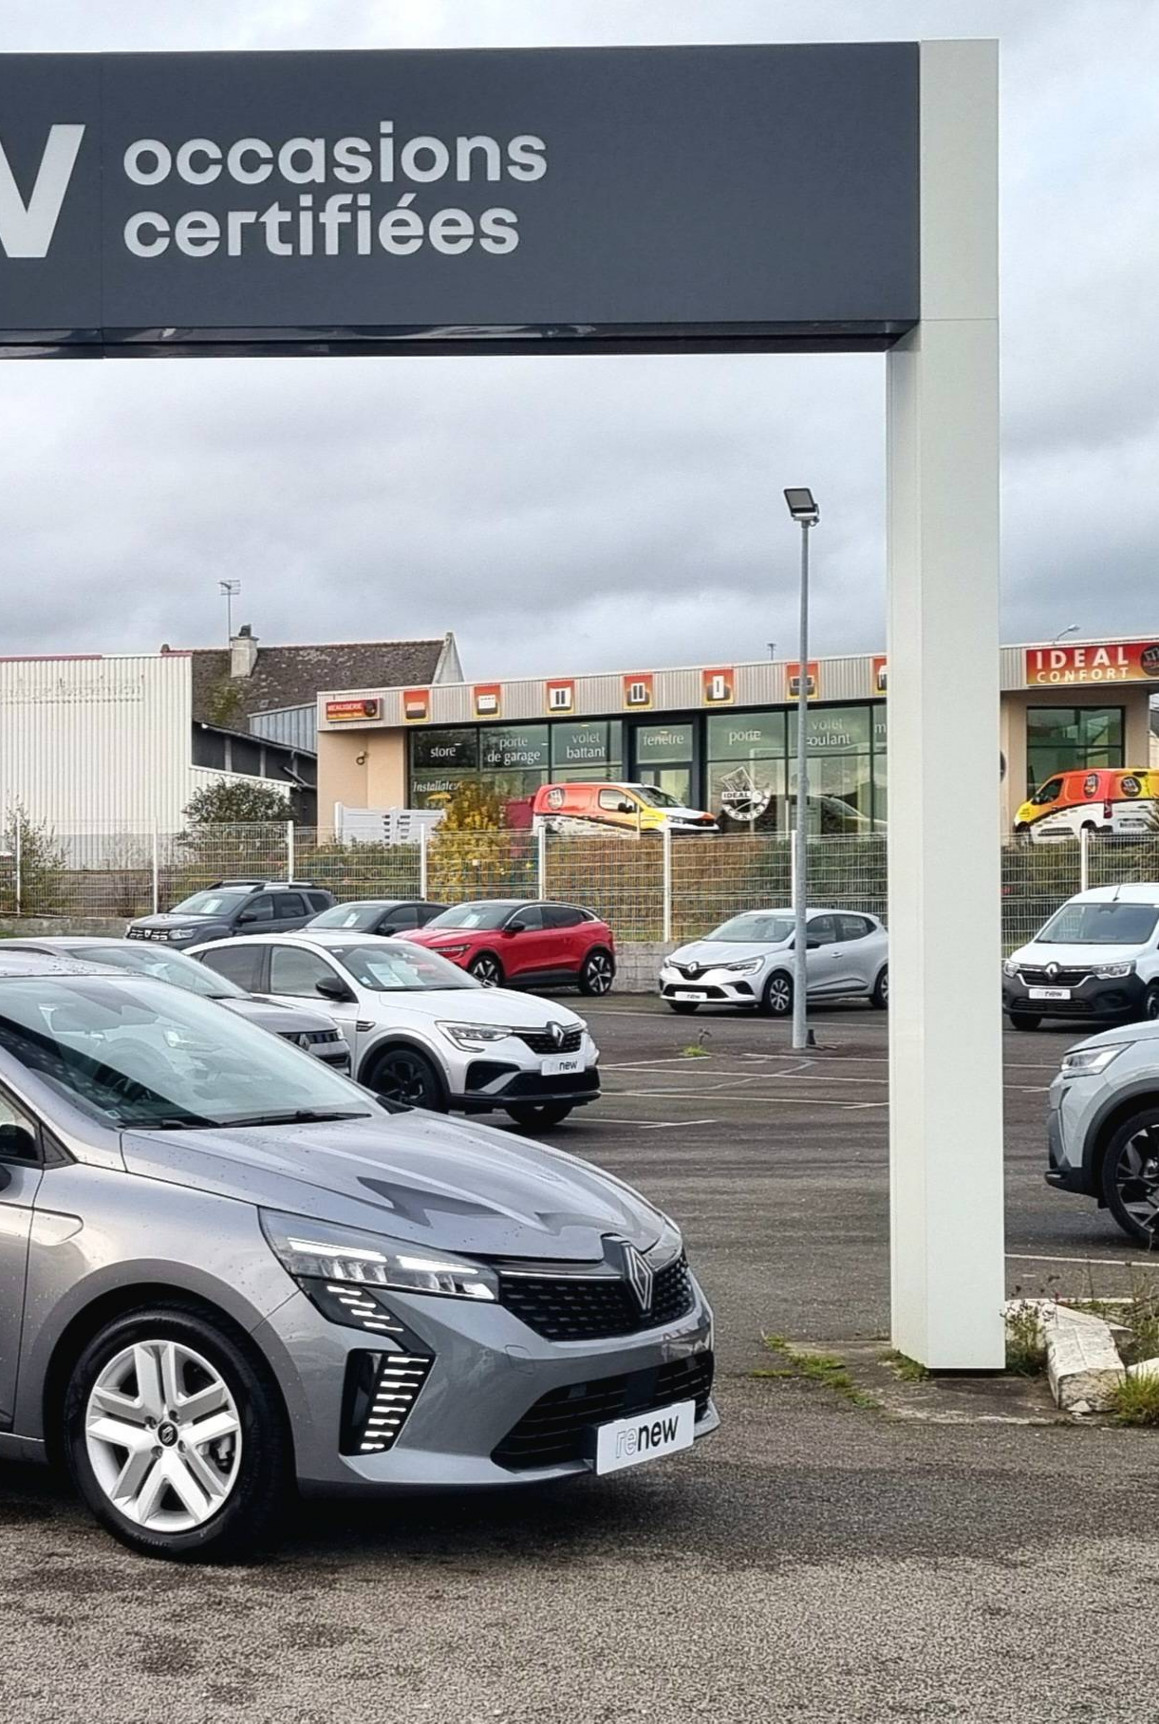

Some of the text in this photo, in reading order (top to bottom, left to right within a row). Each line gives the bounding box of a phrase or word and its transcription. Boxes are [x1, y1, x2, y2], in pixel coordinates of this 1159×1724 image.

[123, 120, 547, 185] occasions
[123, 193, 519, 258] certifiées
[1036, 646, 1129, 669] IDEAL
[1036, 667, 1129, 683] CONFORT
[811, 718, 844, 731] volet
[499, 736, 528, 750] porte
[571, 732, 600, 744] volet
[728, 729, 761, 745] porte
[430, 745, 457, 757] store
[487, 750, 541, 765] de garage
[566, 745, 606, 759] battant
[616, 1415, 679, 1459] renew
